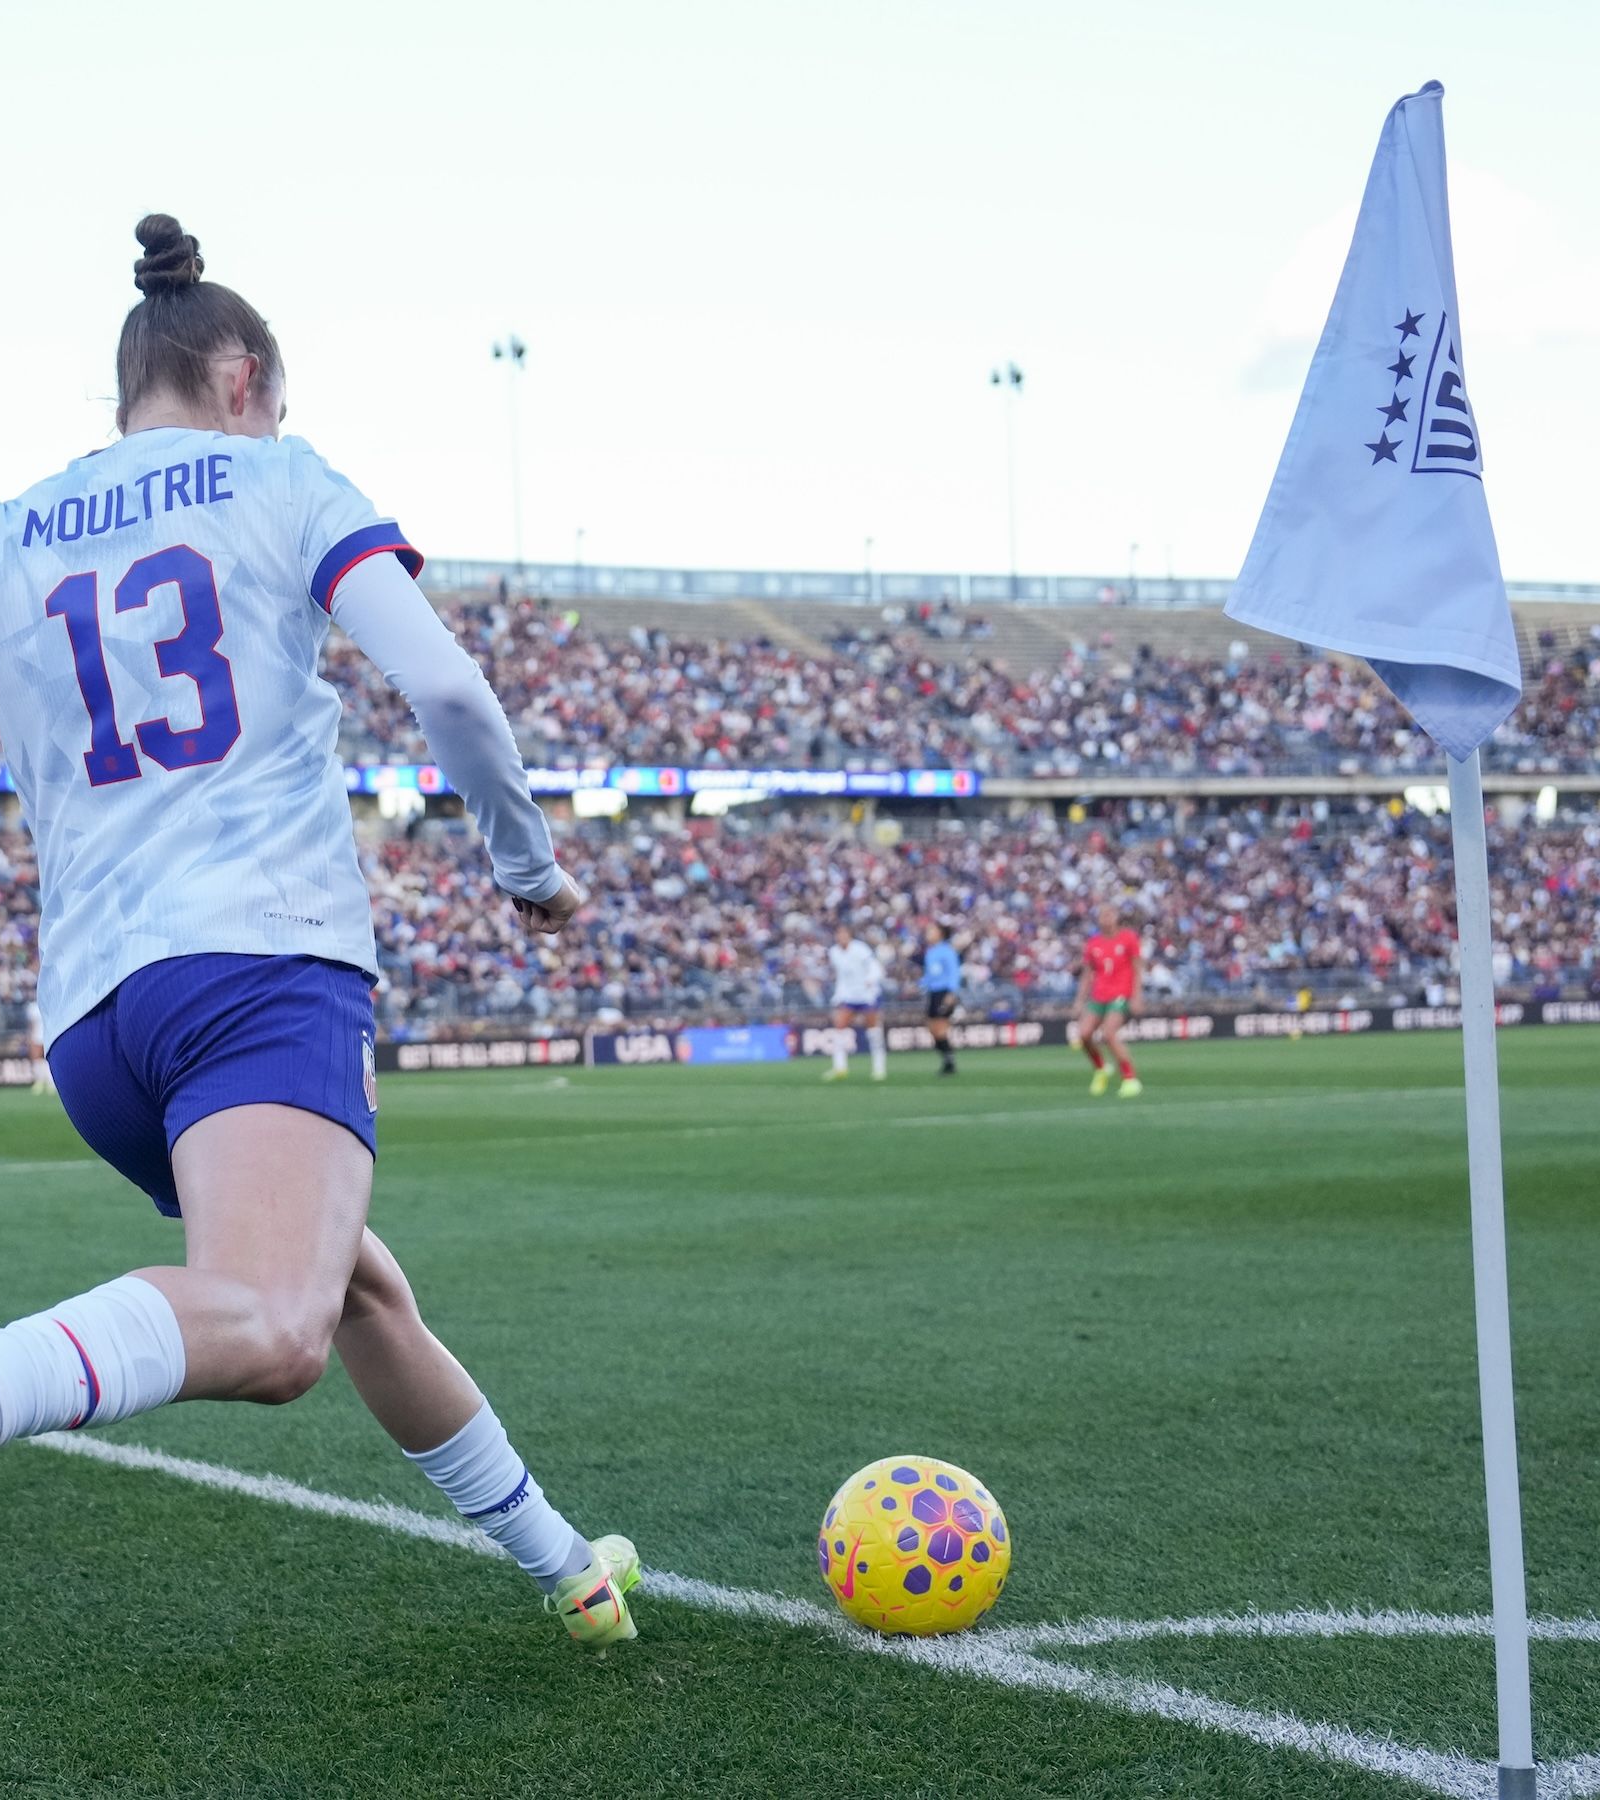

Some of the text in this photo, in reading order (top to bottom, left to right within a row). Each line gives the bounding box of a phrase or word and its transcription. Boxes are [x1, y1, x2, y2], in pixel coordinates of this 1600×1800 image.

[22, 454, 234, 547] MOULTRIE
[45, 543, 242, 787] 13
[615, 1034, 672, 1063] USA
